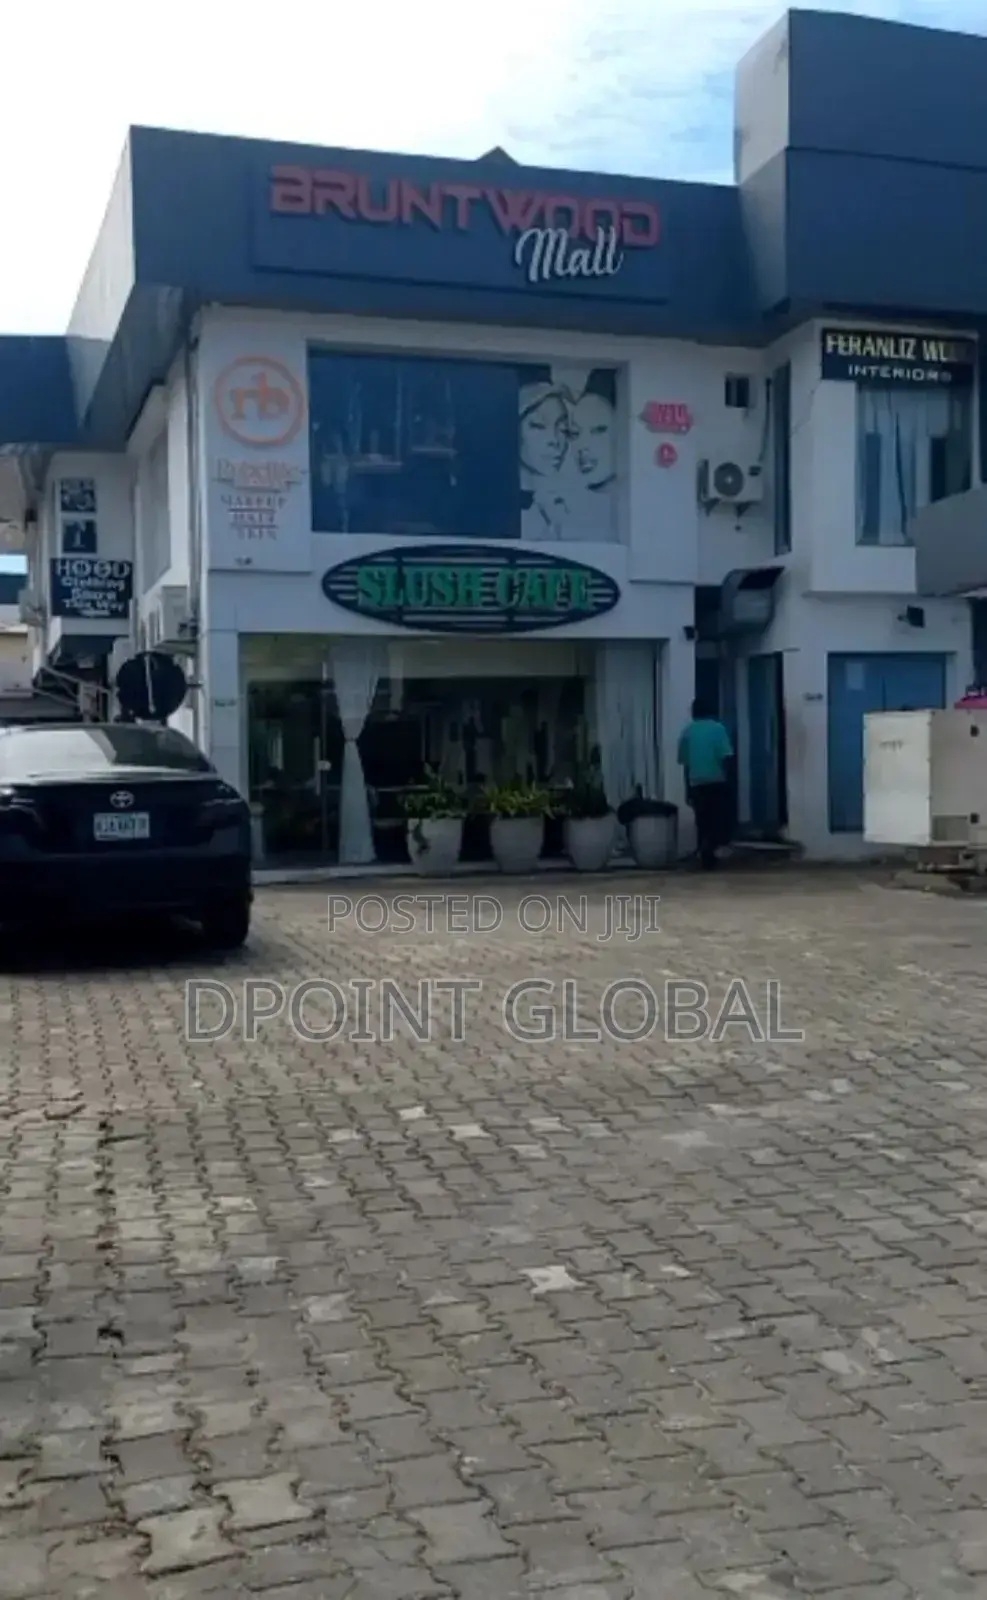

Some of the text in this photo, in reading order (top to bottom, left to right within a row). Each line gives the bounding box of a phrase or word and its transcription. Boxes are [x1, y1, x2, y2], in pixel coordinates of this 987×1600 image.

[270, 165, 661, 249] BRUNTWOOD
[515, 226, 624, 283] Mall
[826, 332, 917, 361] FERANLIZ
[357, 565, 597, 610] SLUSH CAFE
